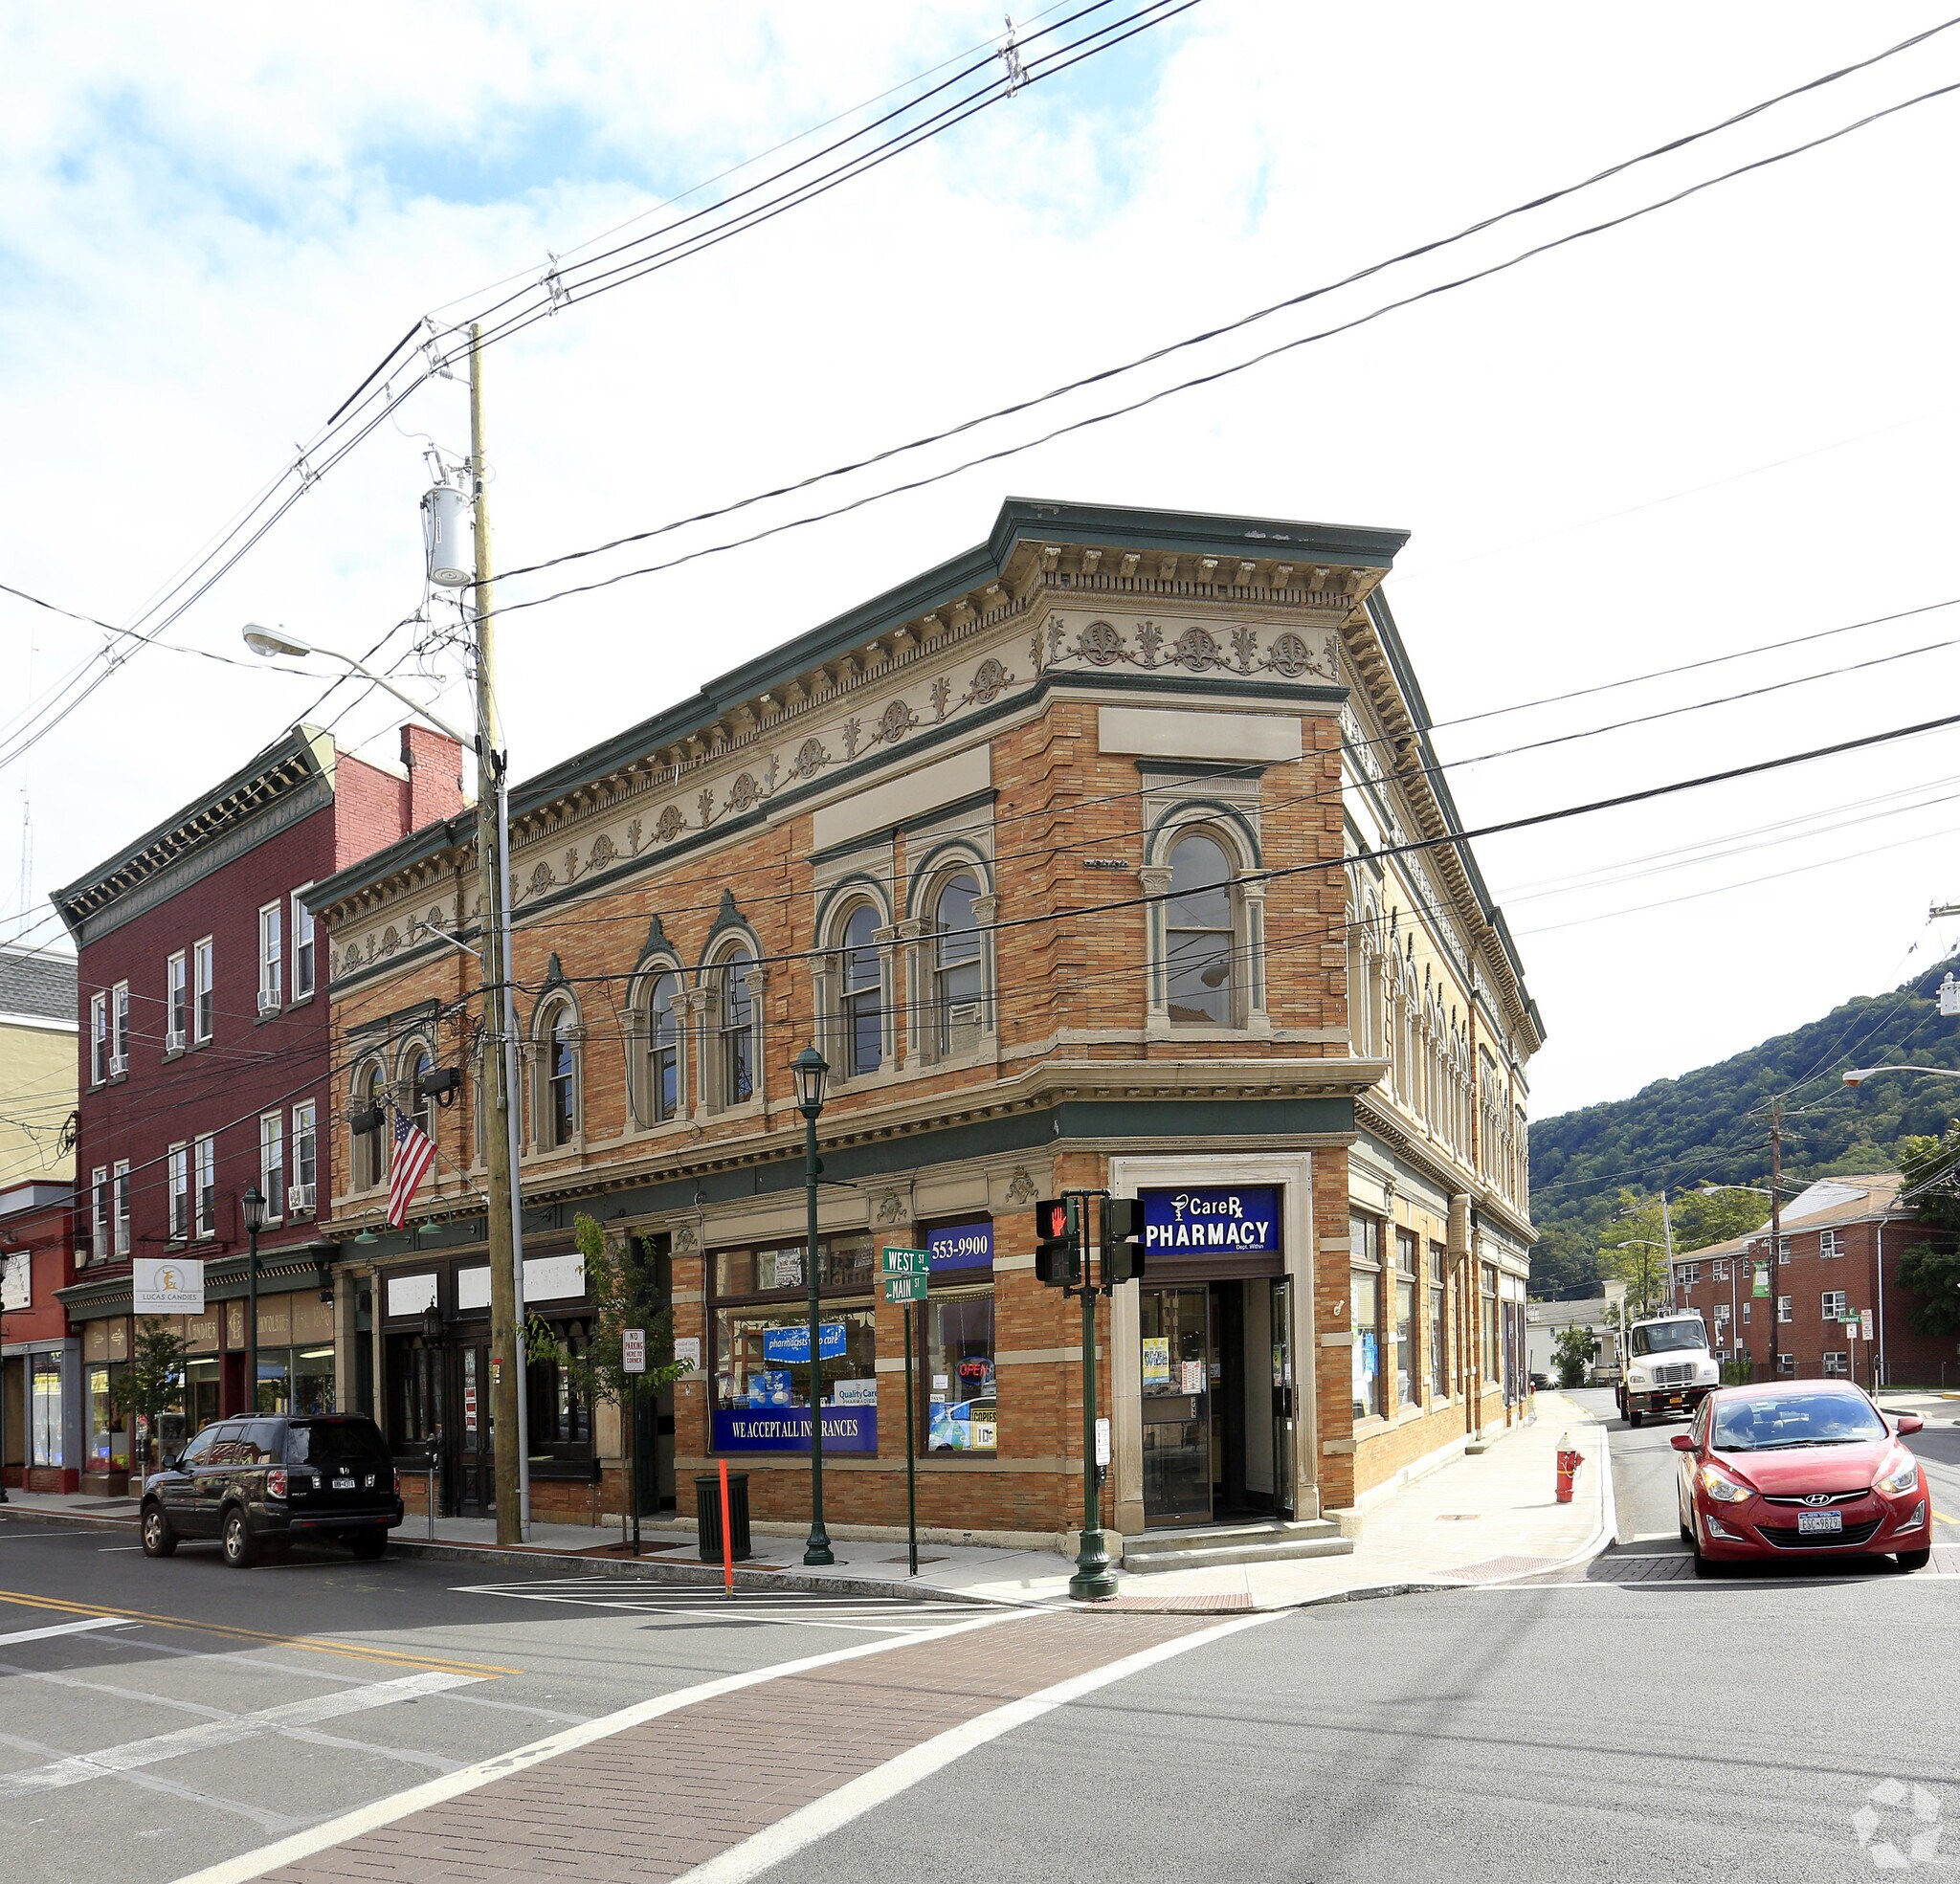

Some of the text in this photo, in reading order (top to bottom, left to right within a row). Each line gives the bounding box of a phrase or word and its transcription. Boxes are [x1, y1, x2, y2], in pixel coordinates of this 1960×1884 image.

[1146, 1221, 1269, 1248] PHARMACY
[931, 1235, 988, 1259] 553-9900
[888, 1251, 915, 1272] WEST
[918, 1253, 925, 1264] ST
[892, 1277, 920, 1299] MAIN ST
[629, 1332, 638, 1341] NO
[768, 1338, 808, 1350] pharmacists
[824, 1336, 838, 1344] care
[625, 1341, 643, 1350] PARKING
[959, 1363, 990, 1376] OPEN
[973, 1411, 997, 1423] COPIES
[732, 1422, 746, 1438] WE
[747, 1421, 781, 1438] ACCEPT
[783, 1420, 799, 1437] ALL
